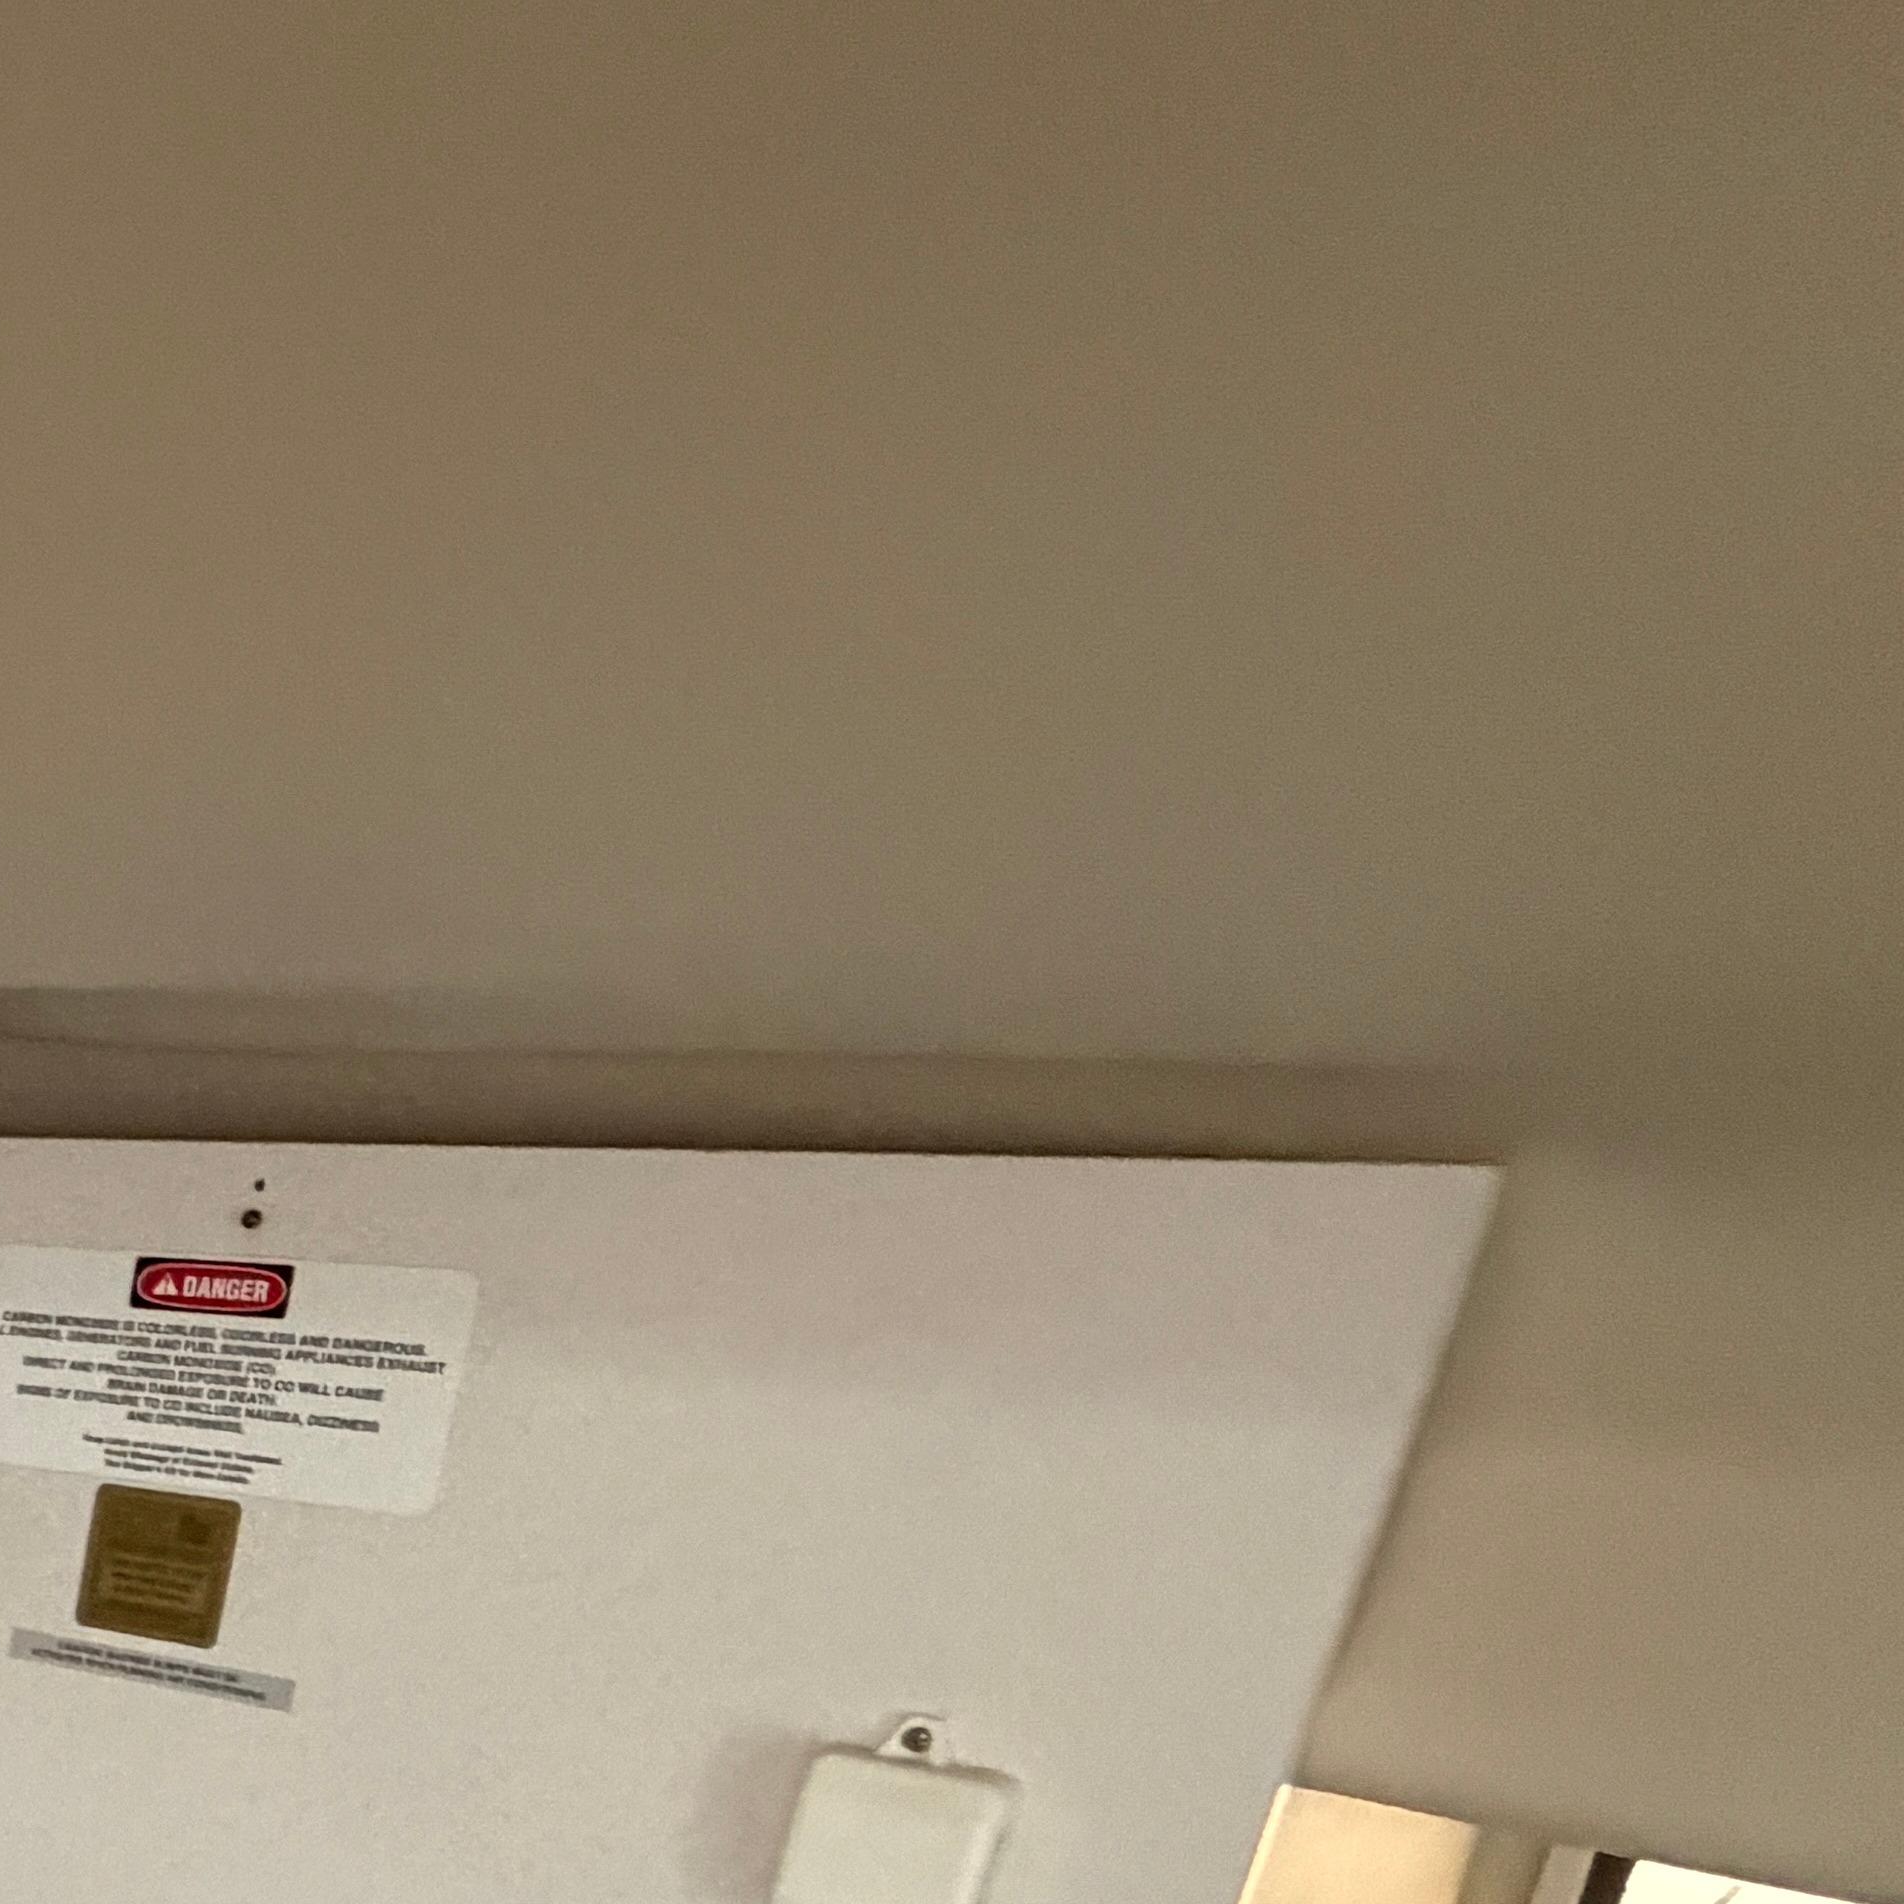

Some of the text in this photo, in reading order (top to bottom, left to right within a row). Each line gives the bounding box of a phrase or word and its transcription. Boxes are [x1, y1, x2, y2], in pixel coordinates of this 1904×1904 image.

[183, 1276, 270, 1303] DANGER
[299, 1335, 330, 1348] AND
[154, 1338, 182, 1351] AND
[184, 1341, 217, 1354] FUEL
[285, 1350, 374, 1368] APPLIANCES
[148, 1382, 205, 1398] DAMAGE
[206, 1388, 227, 1400] OR
[253, 1378, 271, 1390] TO
[298, 1382, 331, 1396] WILL
